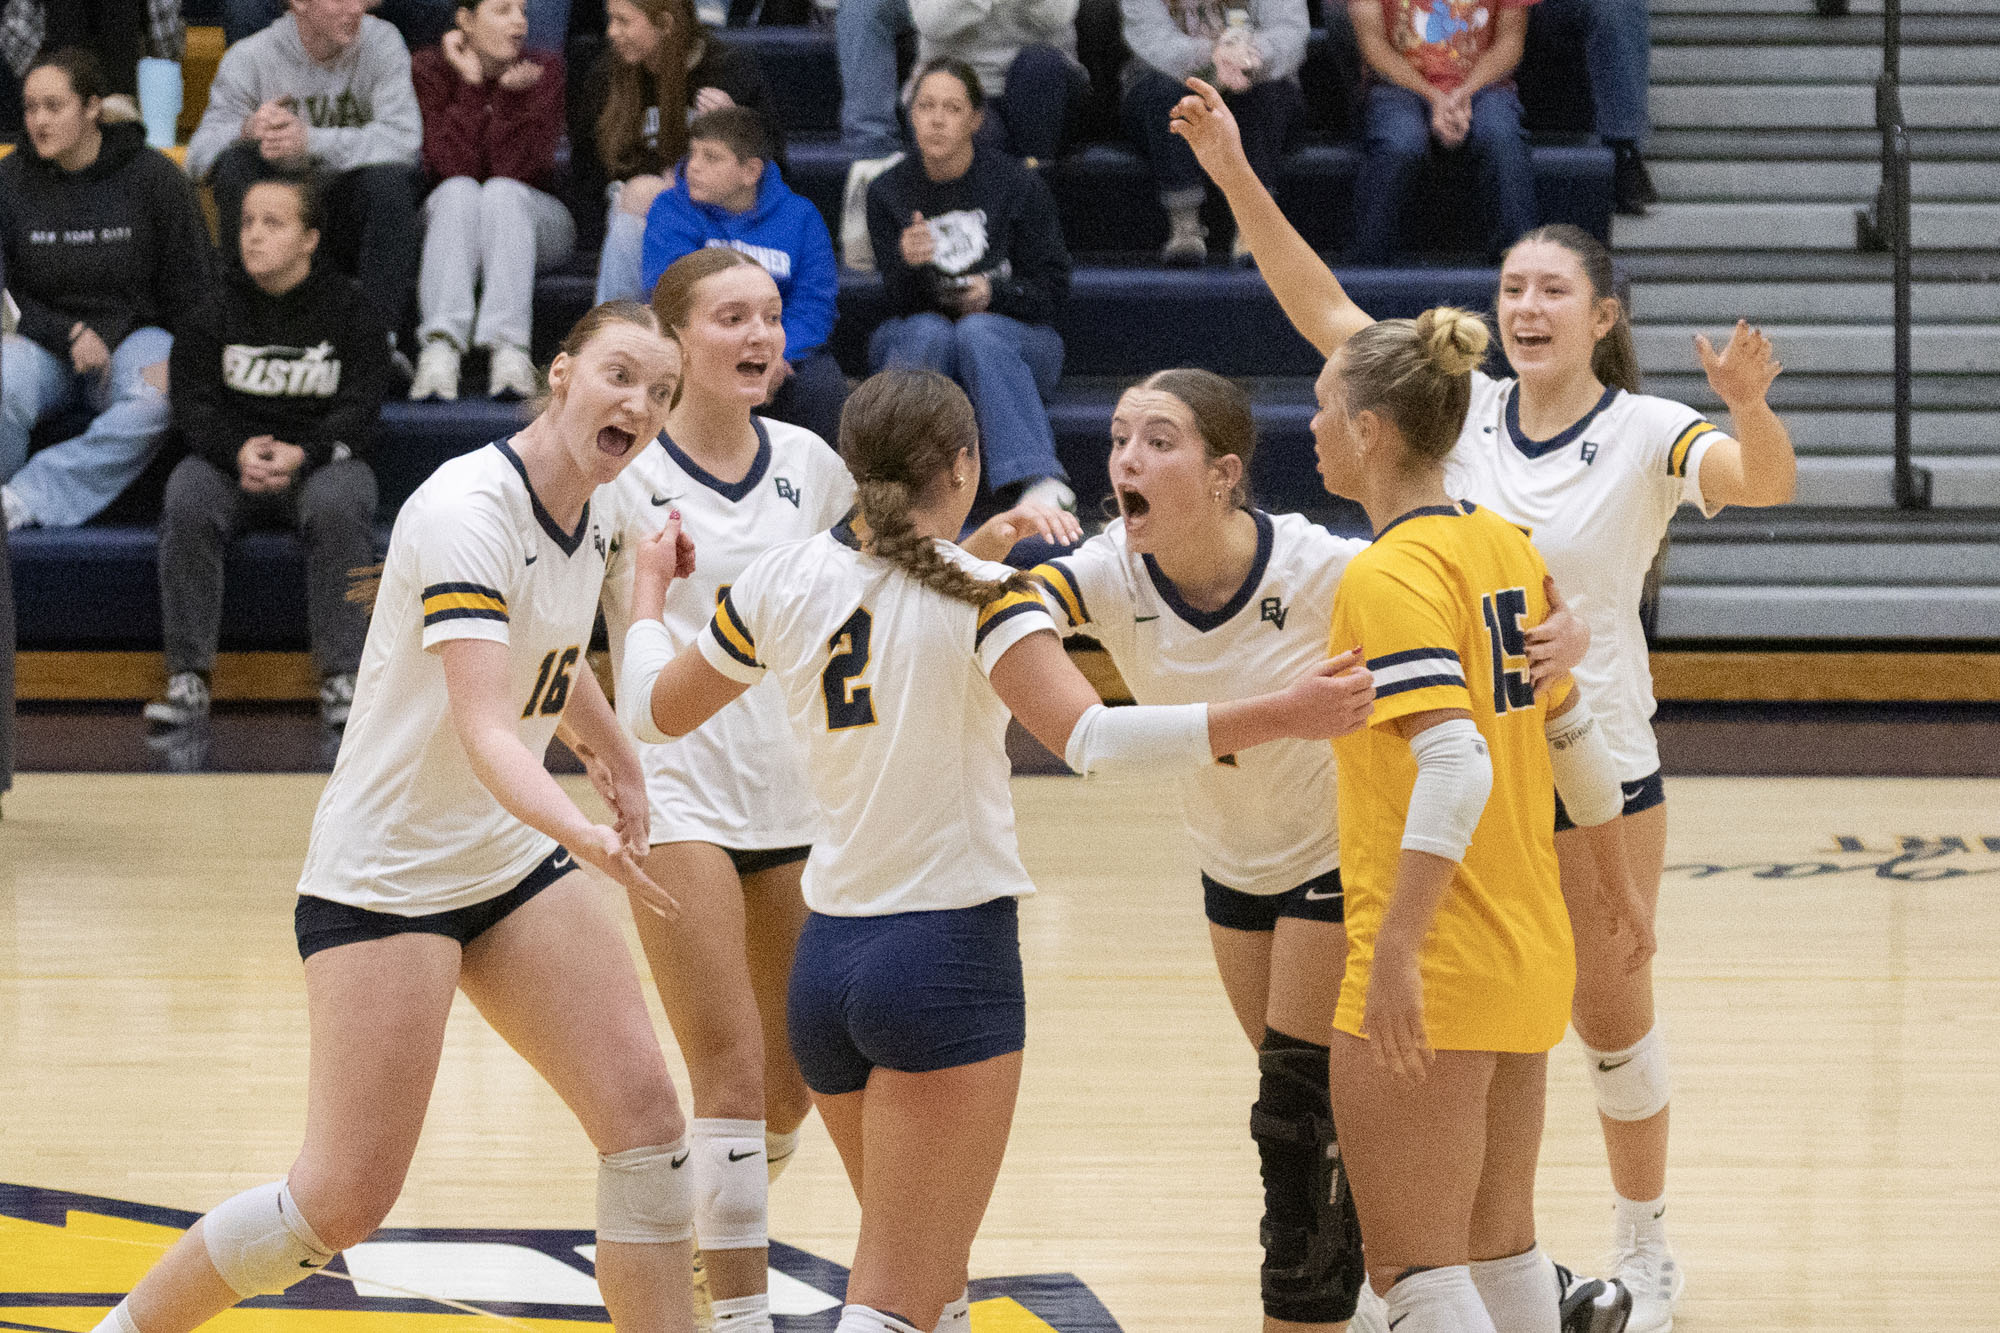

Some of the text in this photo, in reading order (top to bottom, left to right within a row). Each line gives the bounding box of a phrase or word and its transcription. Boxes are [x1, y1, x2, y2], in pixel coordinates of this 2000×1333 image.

[30, 230, 57, 243] NEW
[63, 229, 96, 244] YORK
[773, 476, 801, 509] BV
[1261, 597, 1289, 631] BV
[820, 606, 879, 732] 2
[1482, 587, 1536, 716] 15
[521, 644, 580, 719] 16
